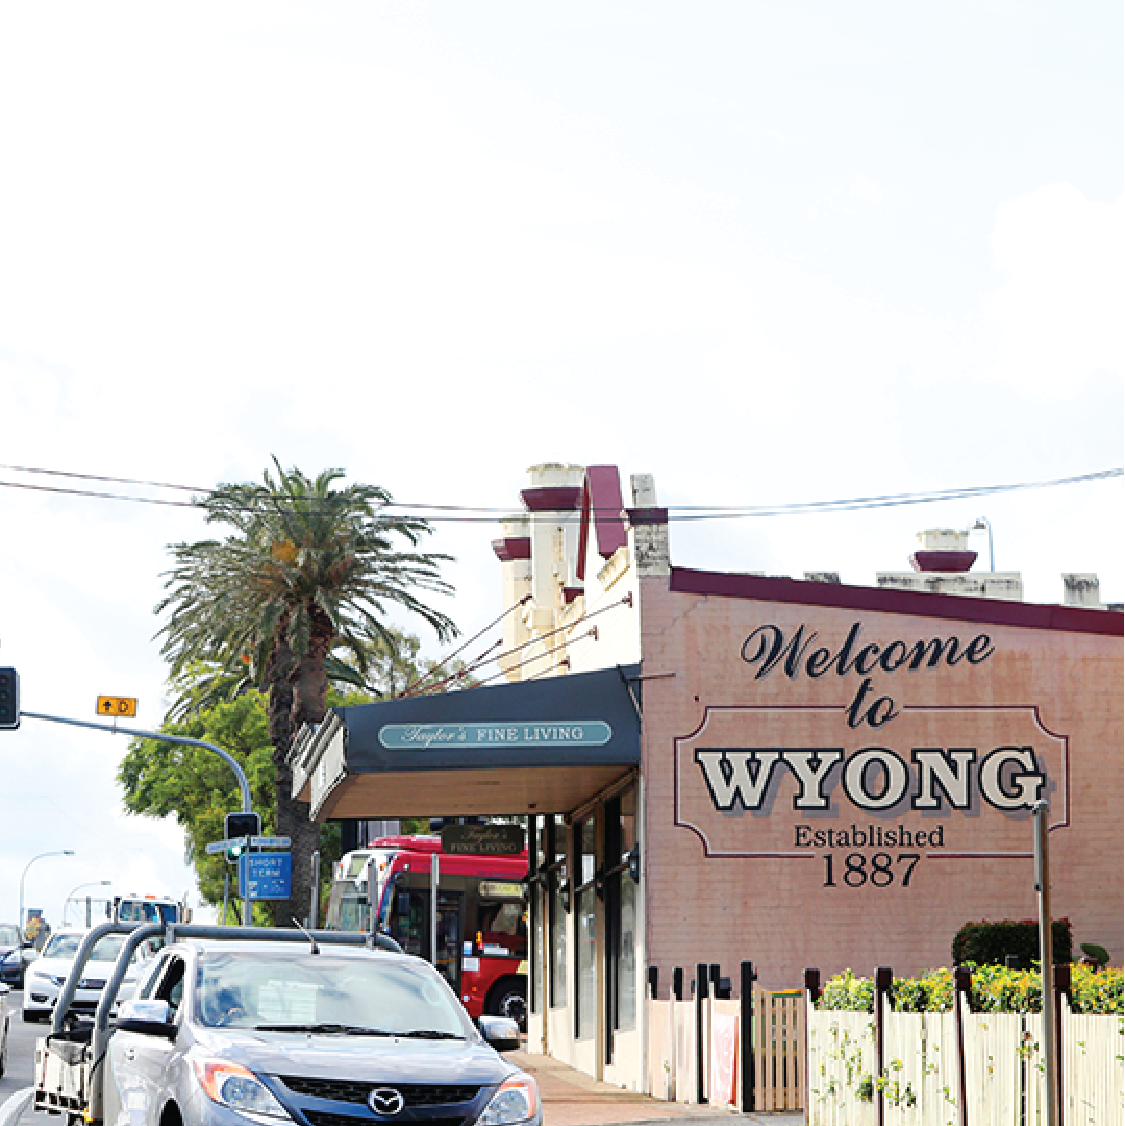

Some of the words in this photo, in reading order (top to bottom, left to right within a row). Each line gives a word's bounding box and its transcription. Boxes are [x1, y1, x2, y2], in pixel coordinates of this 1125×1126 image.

[740, 621, 996, 680] Welcome
[118, 700, 128, 712] D
[845, 678, 899, 729] to
[400, 725, 467, 749] Taylor's
[476, 728, 519, 741] FINE
[524, 726, 584, 740] LIVING
[695, 746, 1046, 811] WYONG
[794, 824, 945, 848] Established
[823, 854, 921, 888] 1887
